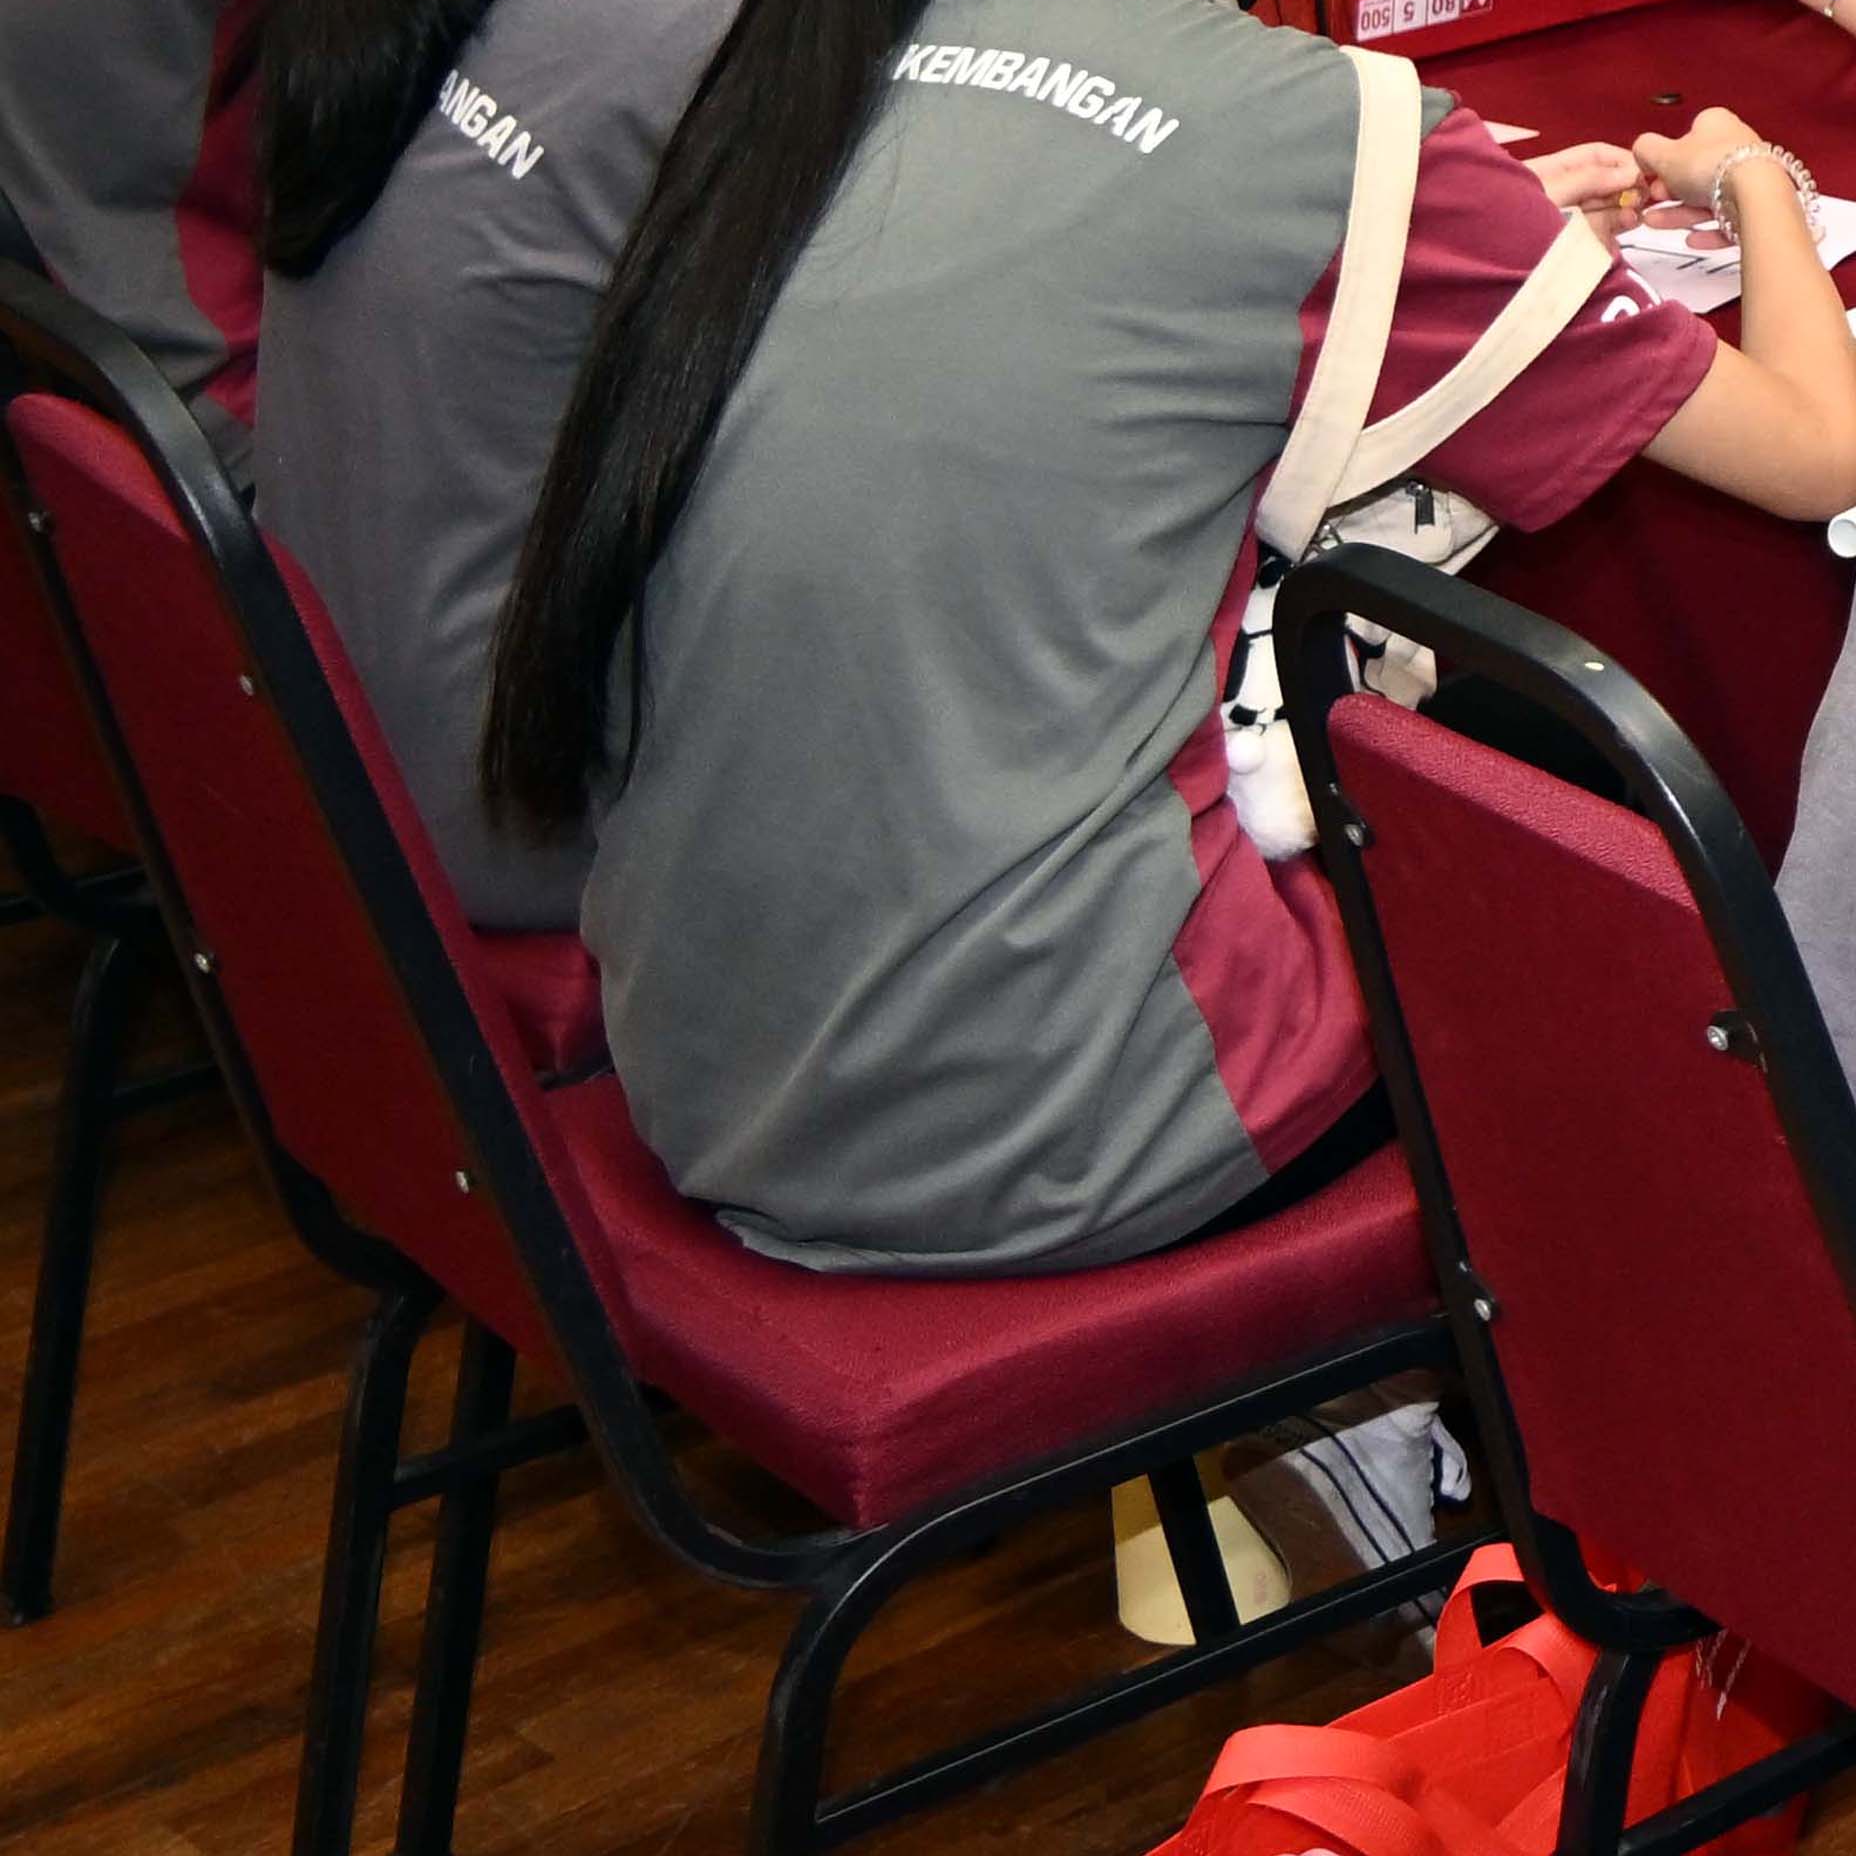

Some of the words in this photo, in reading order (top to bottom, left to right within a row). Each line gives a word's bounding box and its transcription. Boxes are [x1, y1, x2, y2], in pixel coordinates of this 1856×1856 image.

[1361, 7, 1391, 31] 500
[1403, 1, 1415, 22] 5
[440, 69, 545, 179] ANGAN
[892, 43, 1181, 154] KEMBANGAN
